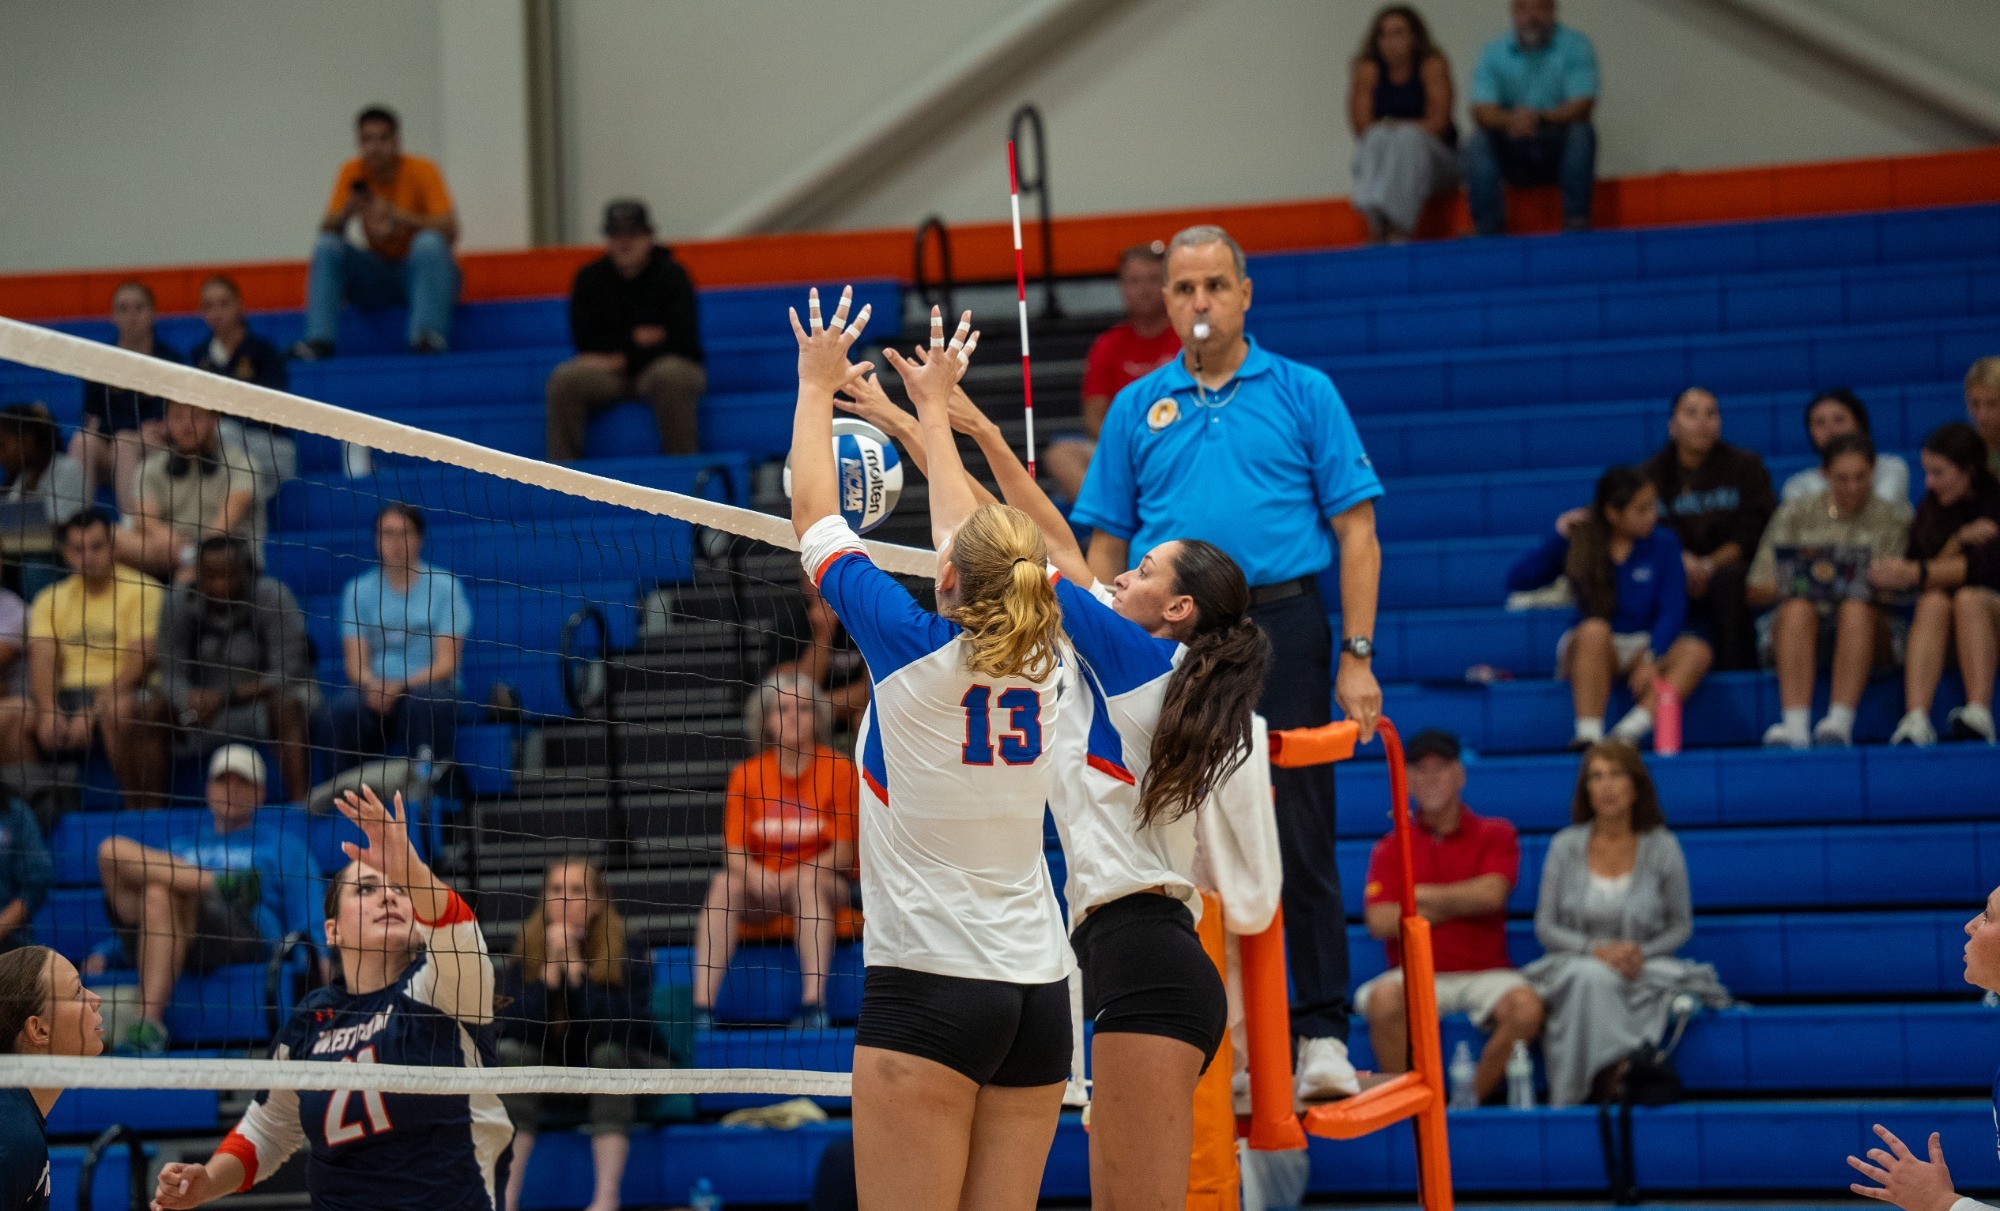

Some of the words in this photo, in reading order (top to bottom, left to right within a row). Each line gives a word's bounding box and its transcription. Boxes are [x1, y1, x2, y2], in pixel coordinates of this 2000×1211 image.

[840, 458, 863, 511] NCAA
[864, 449, 884, 514] molten
[960, 684, 1043, 766] 13
[323, 1044, 393, 1148] 21
